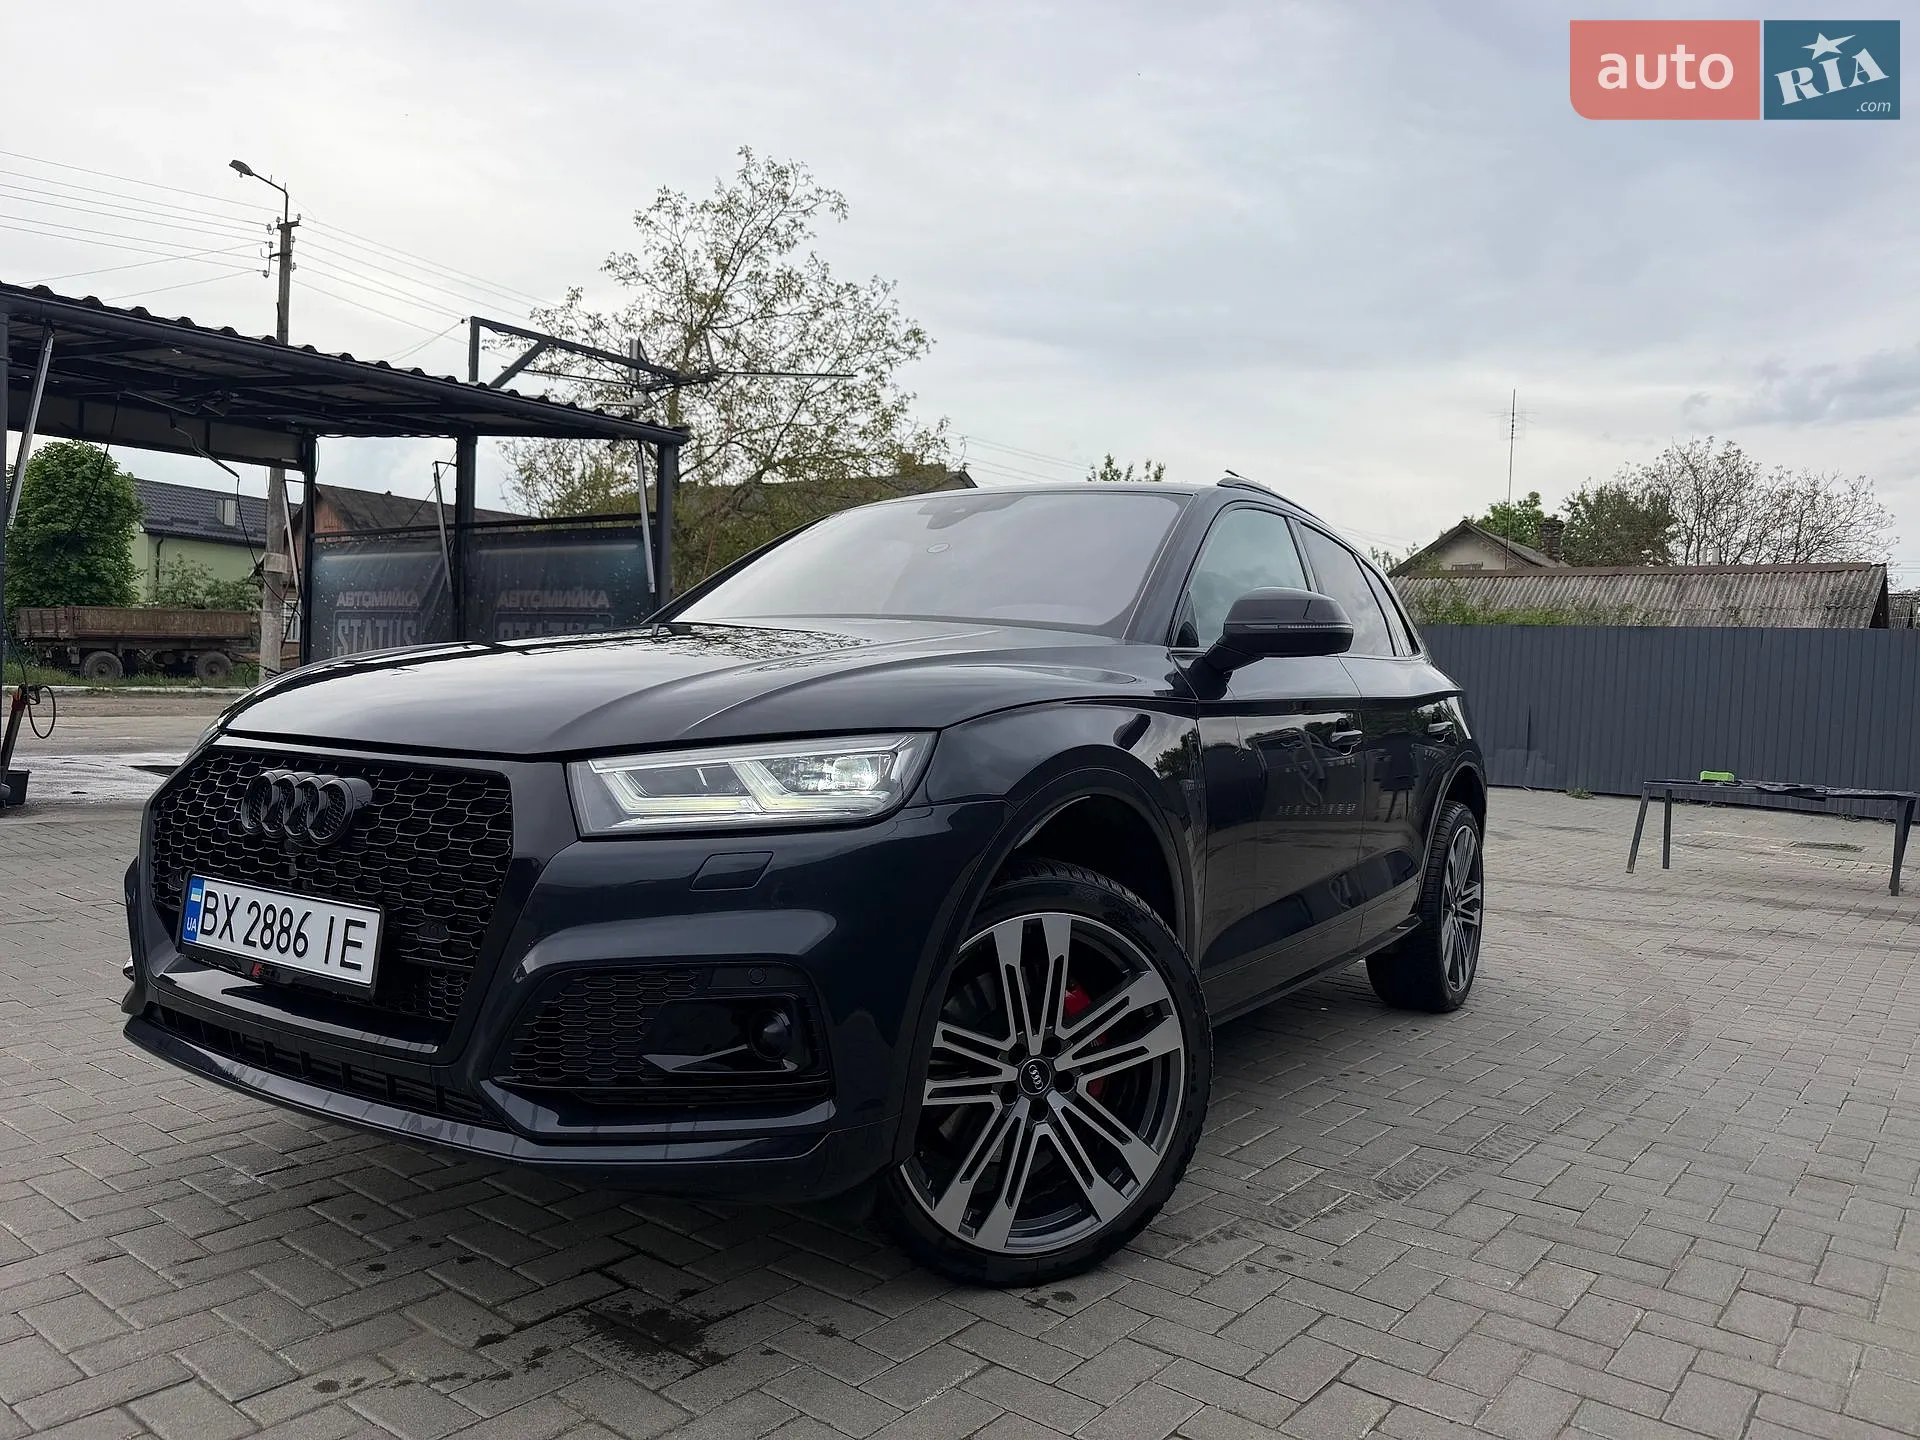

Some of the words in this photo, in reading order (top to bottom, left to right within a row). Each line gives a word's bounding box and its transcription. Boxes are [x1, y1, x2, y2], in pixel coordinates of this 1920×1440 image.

[186, 917, 197, 932] UA
[200, 889, 241, 943] BX
[243, 900, 312, 958] 2886
[324, 915, 367, 971] IE
